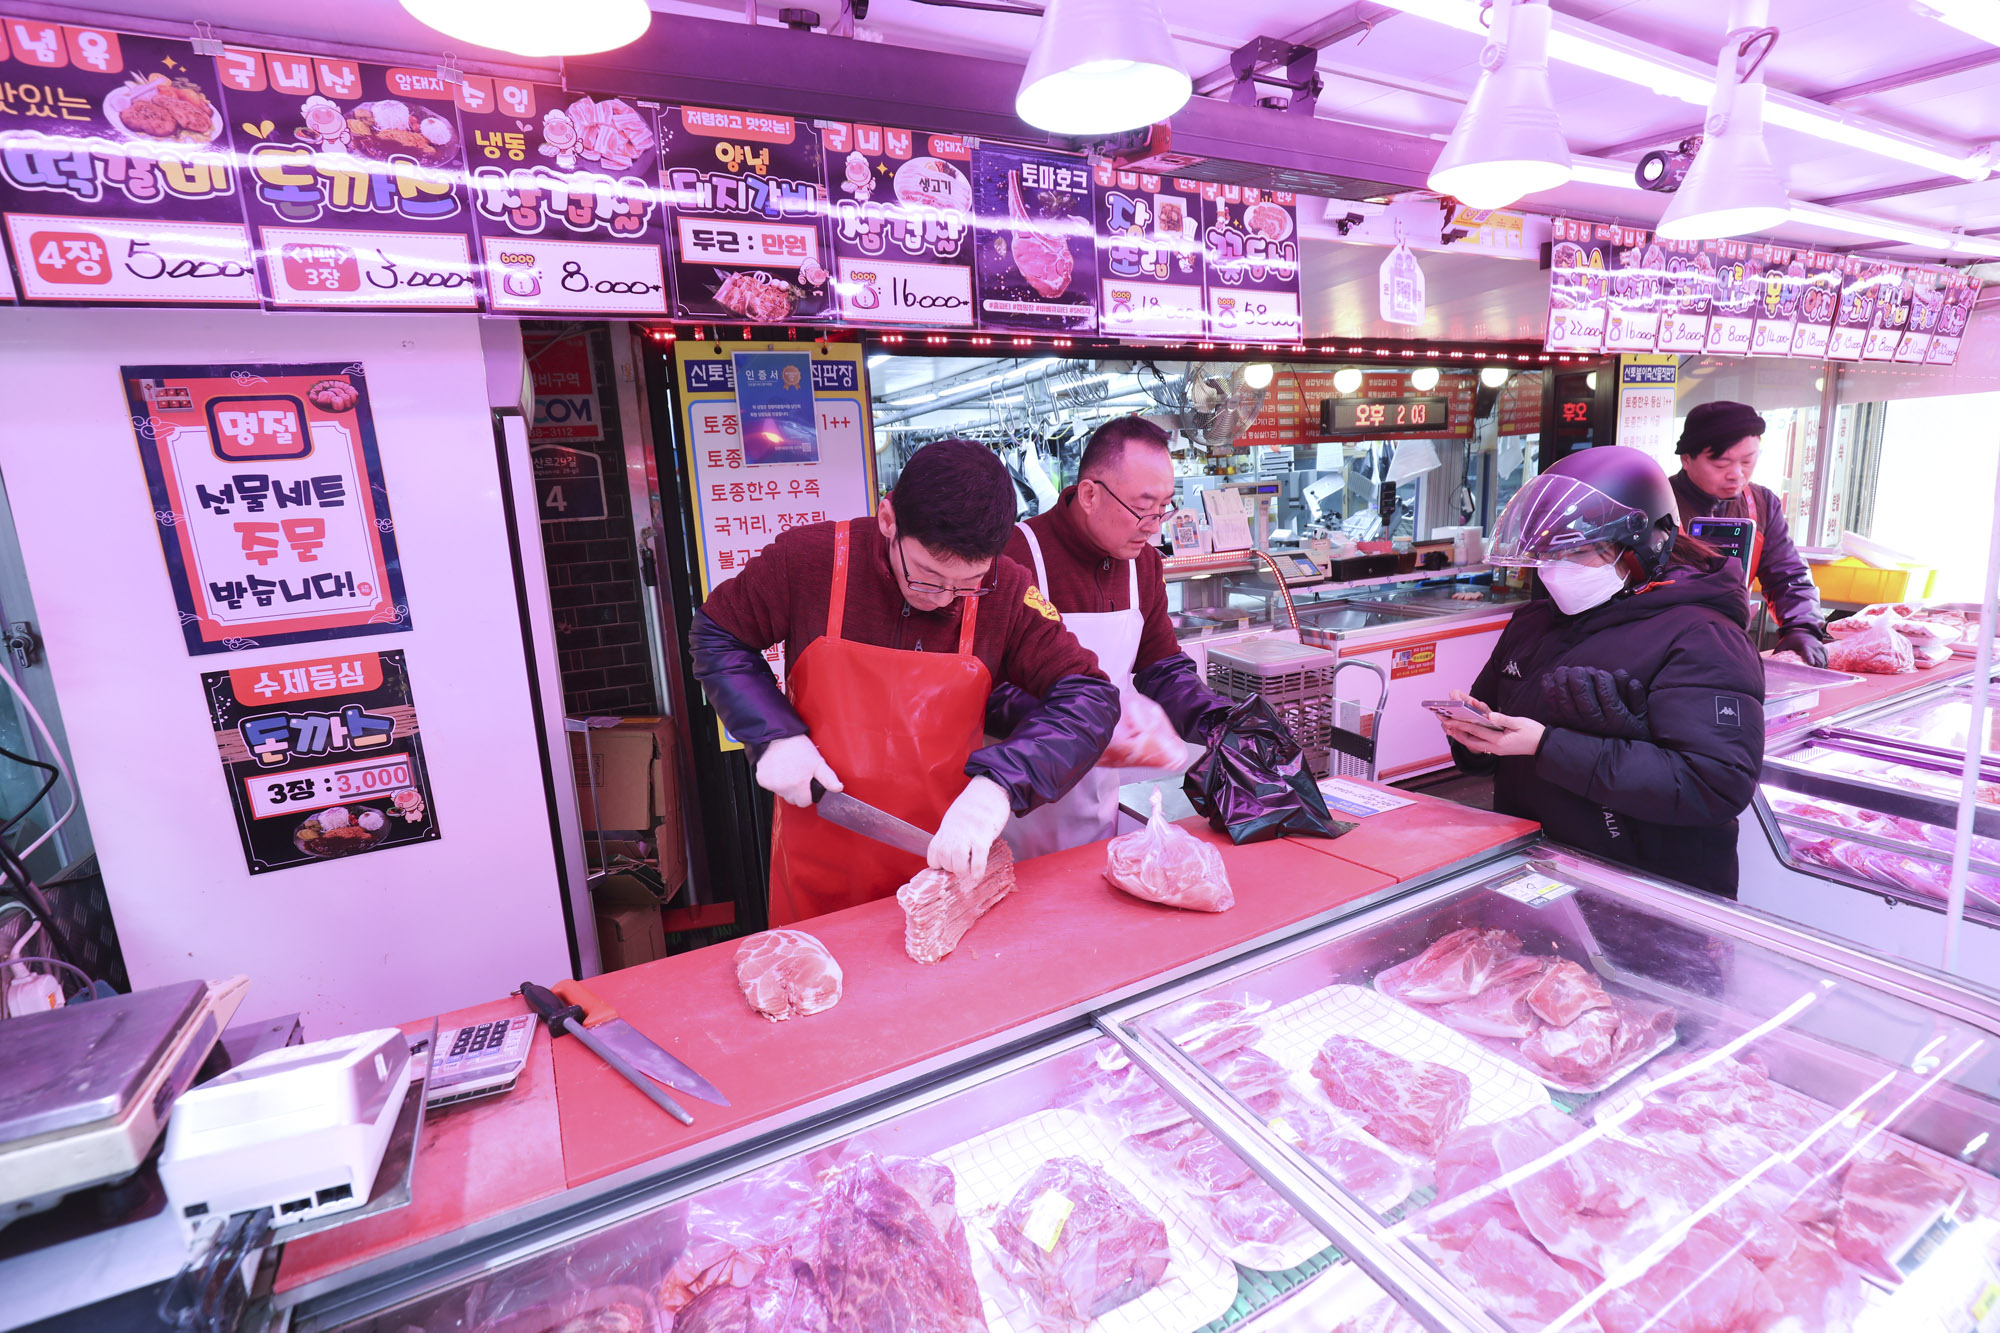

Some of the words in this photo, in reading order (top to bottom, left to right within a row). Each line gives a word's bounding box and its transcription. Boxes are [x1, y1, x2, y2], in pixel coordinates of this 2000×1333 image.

[0, 24, 110, 71] 념육
[225, 52, 356, 94] 국내산
[395, 73, 444, 92] 암돼지
[462, 81, 528, 113] 수입
[687, 111, 742, 129] 저렴하고
[746, 117, 790, 134] 맛있는!
[475, 130, 526, 161] 냉동
[829, 122, 909, 155] 국내산
[2, 136, 230, 199] 떡갈비
[715, 142, 769, 175] 양념
[255, 148, 457, 219] 돈까스
[919, 178, 951, 195] 생고기
[1022, 162, 1088, 194] 토마호크
[480, 170, 652, 231] 삼겹살
[671, 172, 816, 216] 돼지갈비
[692, 229, 739, 253] 두근
[761, 234, 807, 256] 만원
[840, 203, 963, 253] 삼겹살
[38, 240, 103, 277] 4장
[500, 252, 535, 267] 600g
[1207, 230, 1296, 282] 꽃등심
[1575, 250, 1604, 270] LA
[305, 268, 340, 289] 3장
[851, 271, 876, 284] 600g
[534, 371, 580, 389] 비구역
[1624, 366, 1676, 382] 신토불이축산물직판장
[534, 398, 593, 423] COM
[1355, 404, 1385, 427] 오후
[1397, 405, 1405, 425] 2
[1411, 404, 1426, 424] 03
[1625, 396, 1648, 408] 토종한우
[219, 410, 297, 445] 명절
[704, 414, 738, 435] 토종
[822, 413, 850, 430] 1++
[533, 456, 577, 469] 산로29길
[708, 449, 742, 469] 토종
[196, 474, 346, 514] 선물세트
[546, 485, 567, 511] 4
[711, 481, 781, 502] 토종한우
[788, 479, 820, 498] 우족
[714, 514, 772, 536] 국거리,
[1734, 527, 1741, 536] 0
[234, 518, 326, 566] 주문
[718, 549, 762, 570] 불고
[209, 571, 356, 609] 받습니다!
[254, 660, 365, 699] 수제등심
[243, 709, 395, 763] 돈까스
[267, 777, 316, 805] 3장
[336, 767, 408, 795] 3,000
[1602, 806, 1620, 838] ALIA
